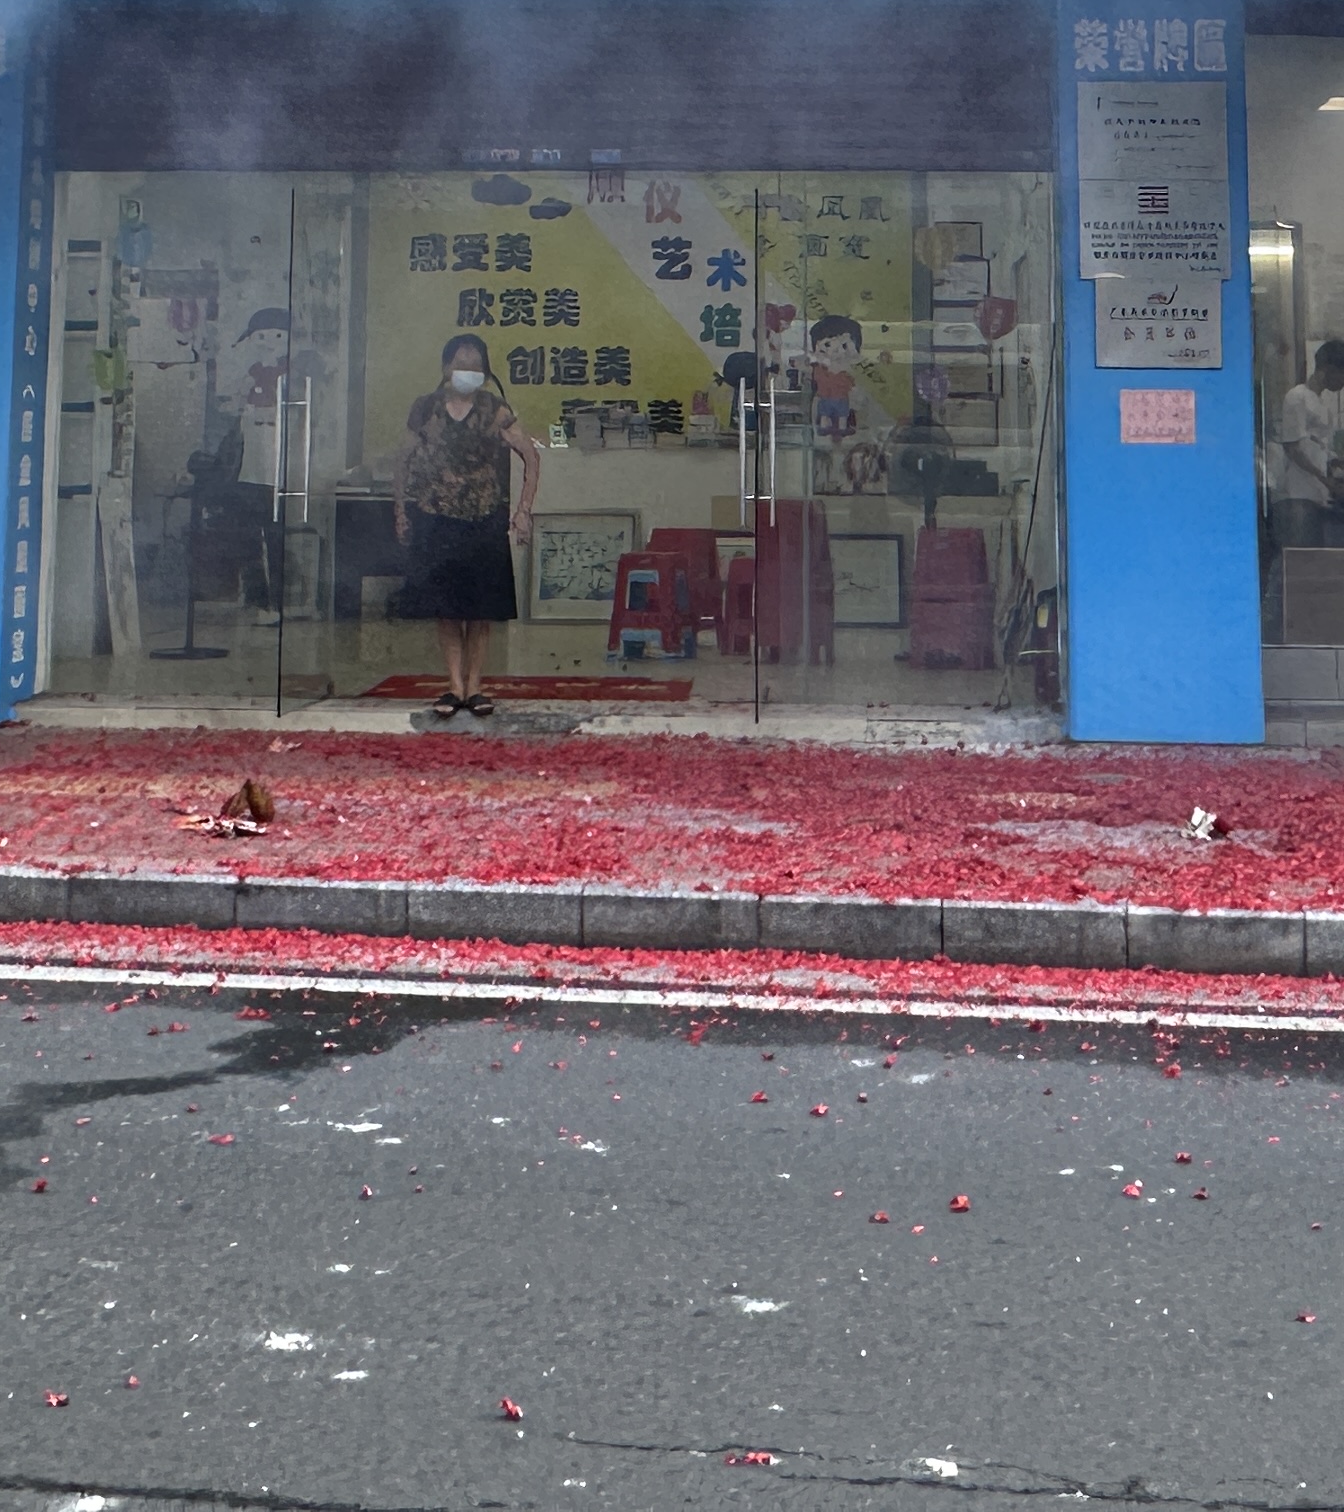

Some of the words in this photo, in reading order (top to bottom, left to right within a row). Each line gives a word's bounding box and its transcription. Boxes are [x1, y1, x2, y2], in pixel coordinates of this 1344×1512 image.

[409, 232, 533, 273] 感受美
[457, 287, 581, 327] 欣赏美
[506, 345, 632, 387] 创造美
